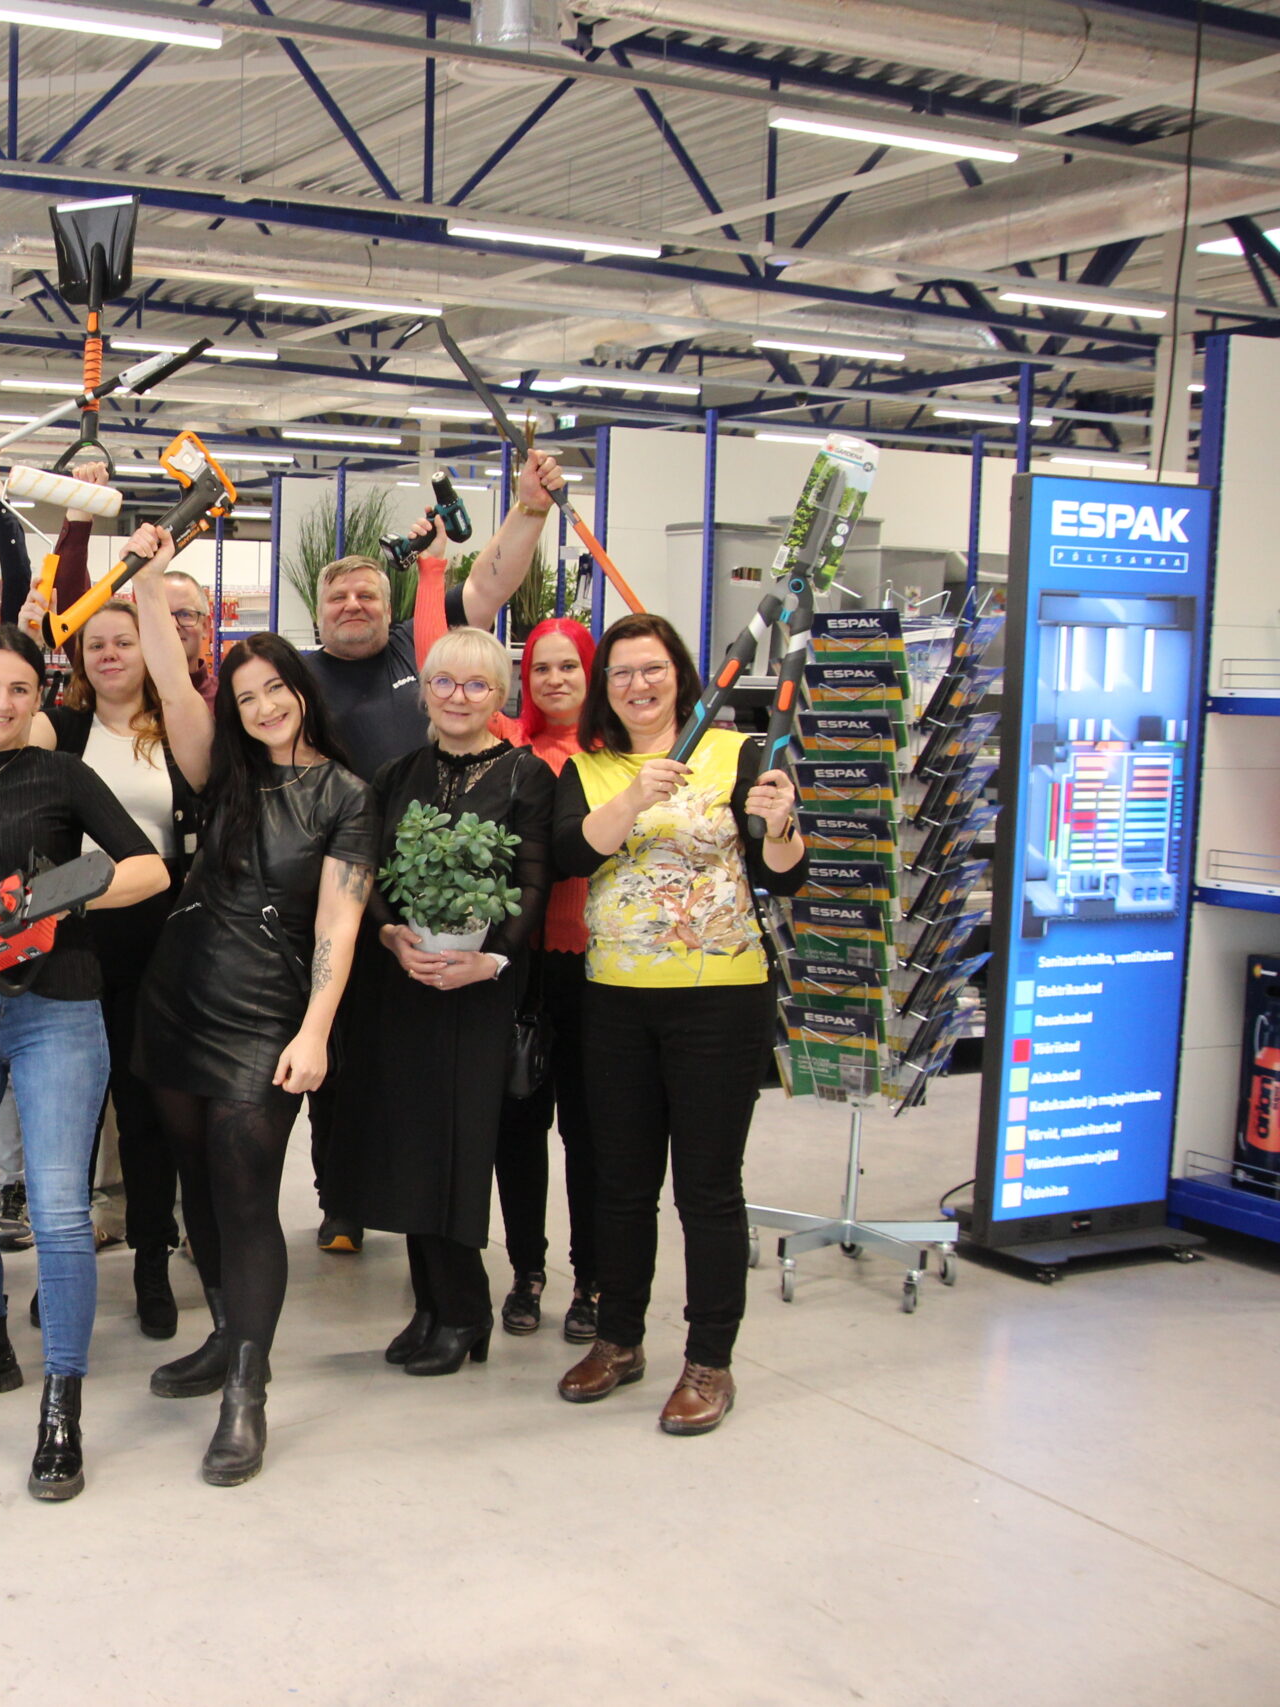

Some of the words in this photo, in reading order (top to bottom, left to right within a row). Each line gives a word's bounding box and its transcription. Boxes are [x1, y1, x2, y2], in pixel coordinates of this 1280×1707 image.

[1051, 499, 1190, 543] ESPAK
[827, 618, 881, 629] ESPAK
[823, 669, 876, 679] ESPAK
[817, 720, 871, 729] ESPAK
[814, 768, 868, 778] ESPAK
[816, 819, 869, 830] ESPAK
[808, 867, 861, 878] ESPAK
[809, 906, 862, 919] ESPAK
[806, 965, 859, 978] ESPAK
[804, 1012, 856, 1027] ESPAK
